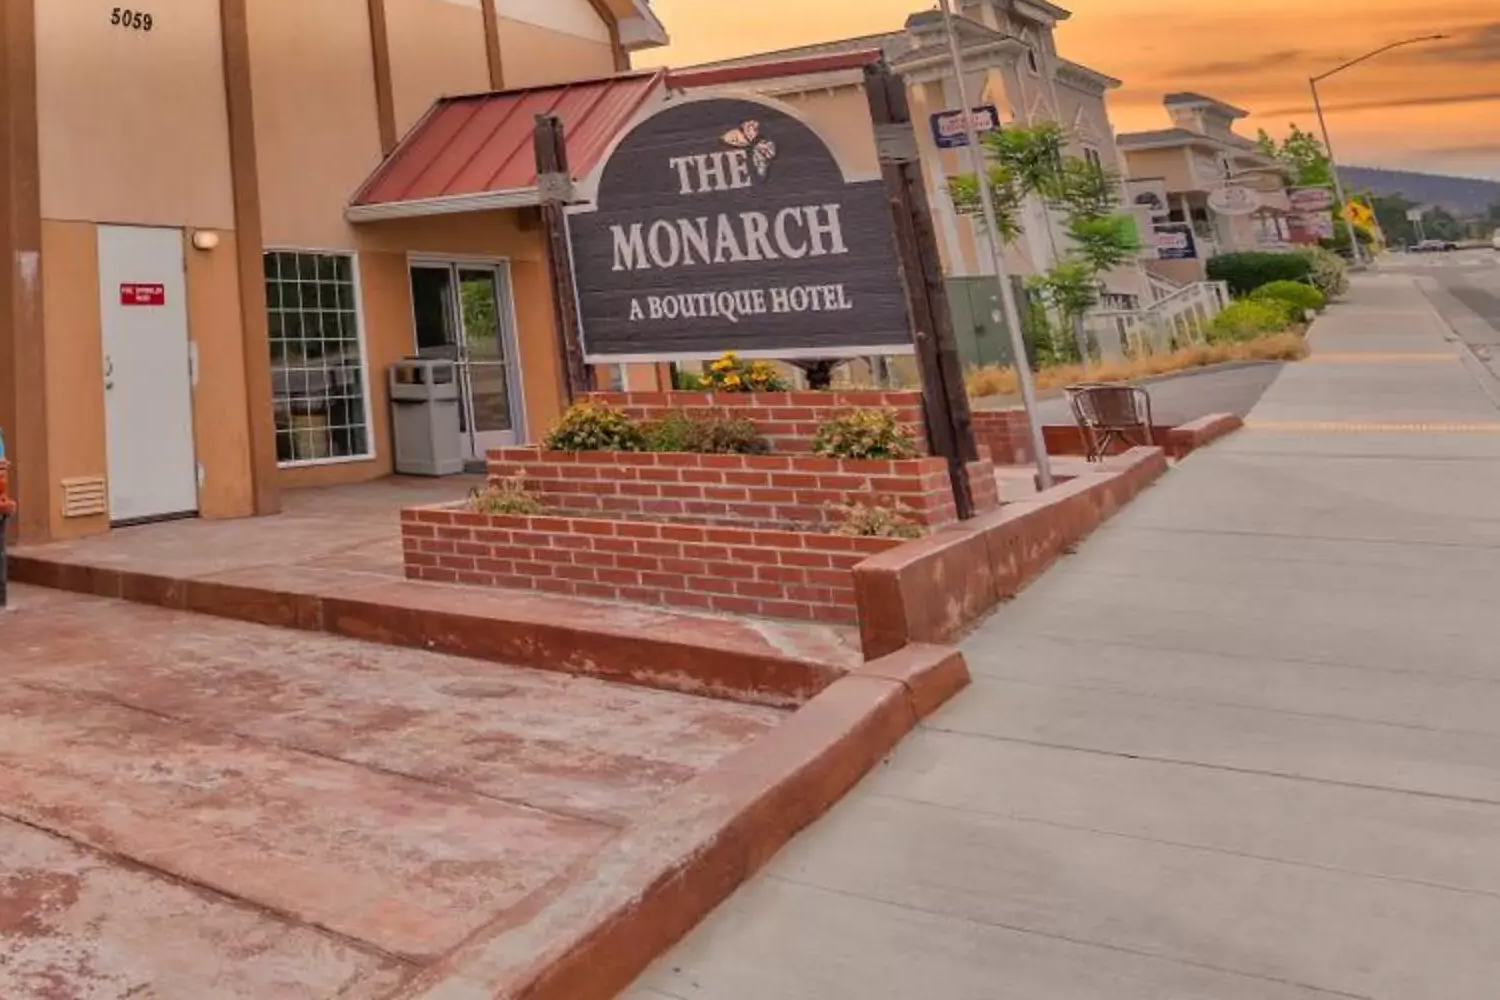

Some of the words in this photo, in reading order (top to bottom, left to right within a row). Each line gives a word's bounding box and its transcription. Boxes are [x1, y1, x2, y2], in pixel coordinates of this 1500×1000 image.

[110, 7, 153, 32] 5059
[669, 150, 752, 195] THE
[609, 202, 849, 272] MONARCH
[629, 298, 645, 321] A
[649, 289, 767, 323] BOUTIQUE
[768, 284, 853, 313] HOTEL
